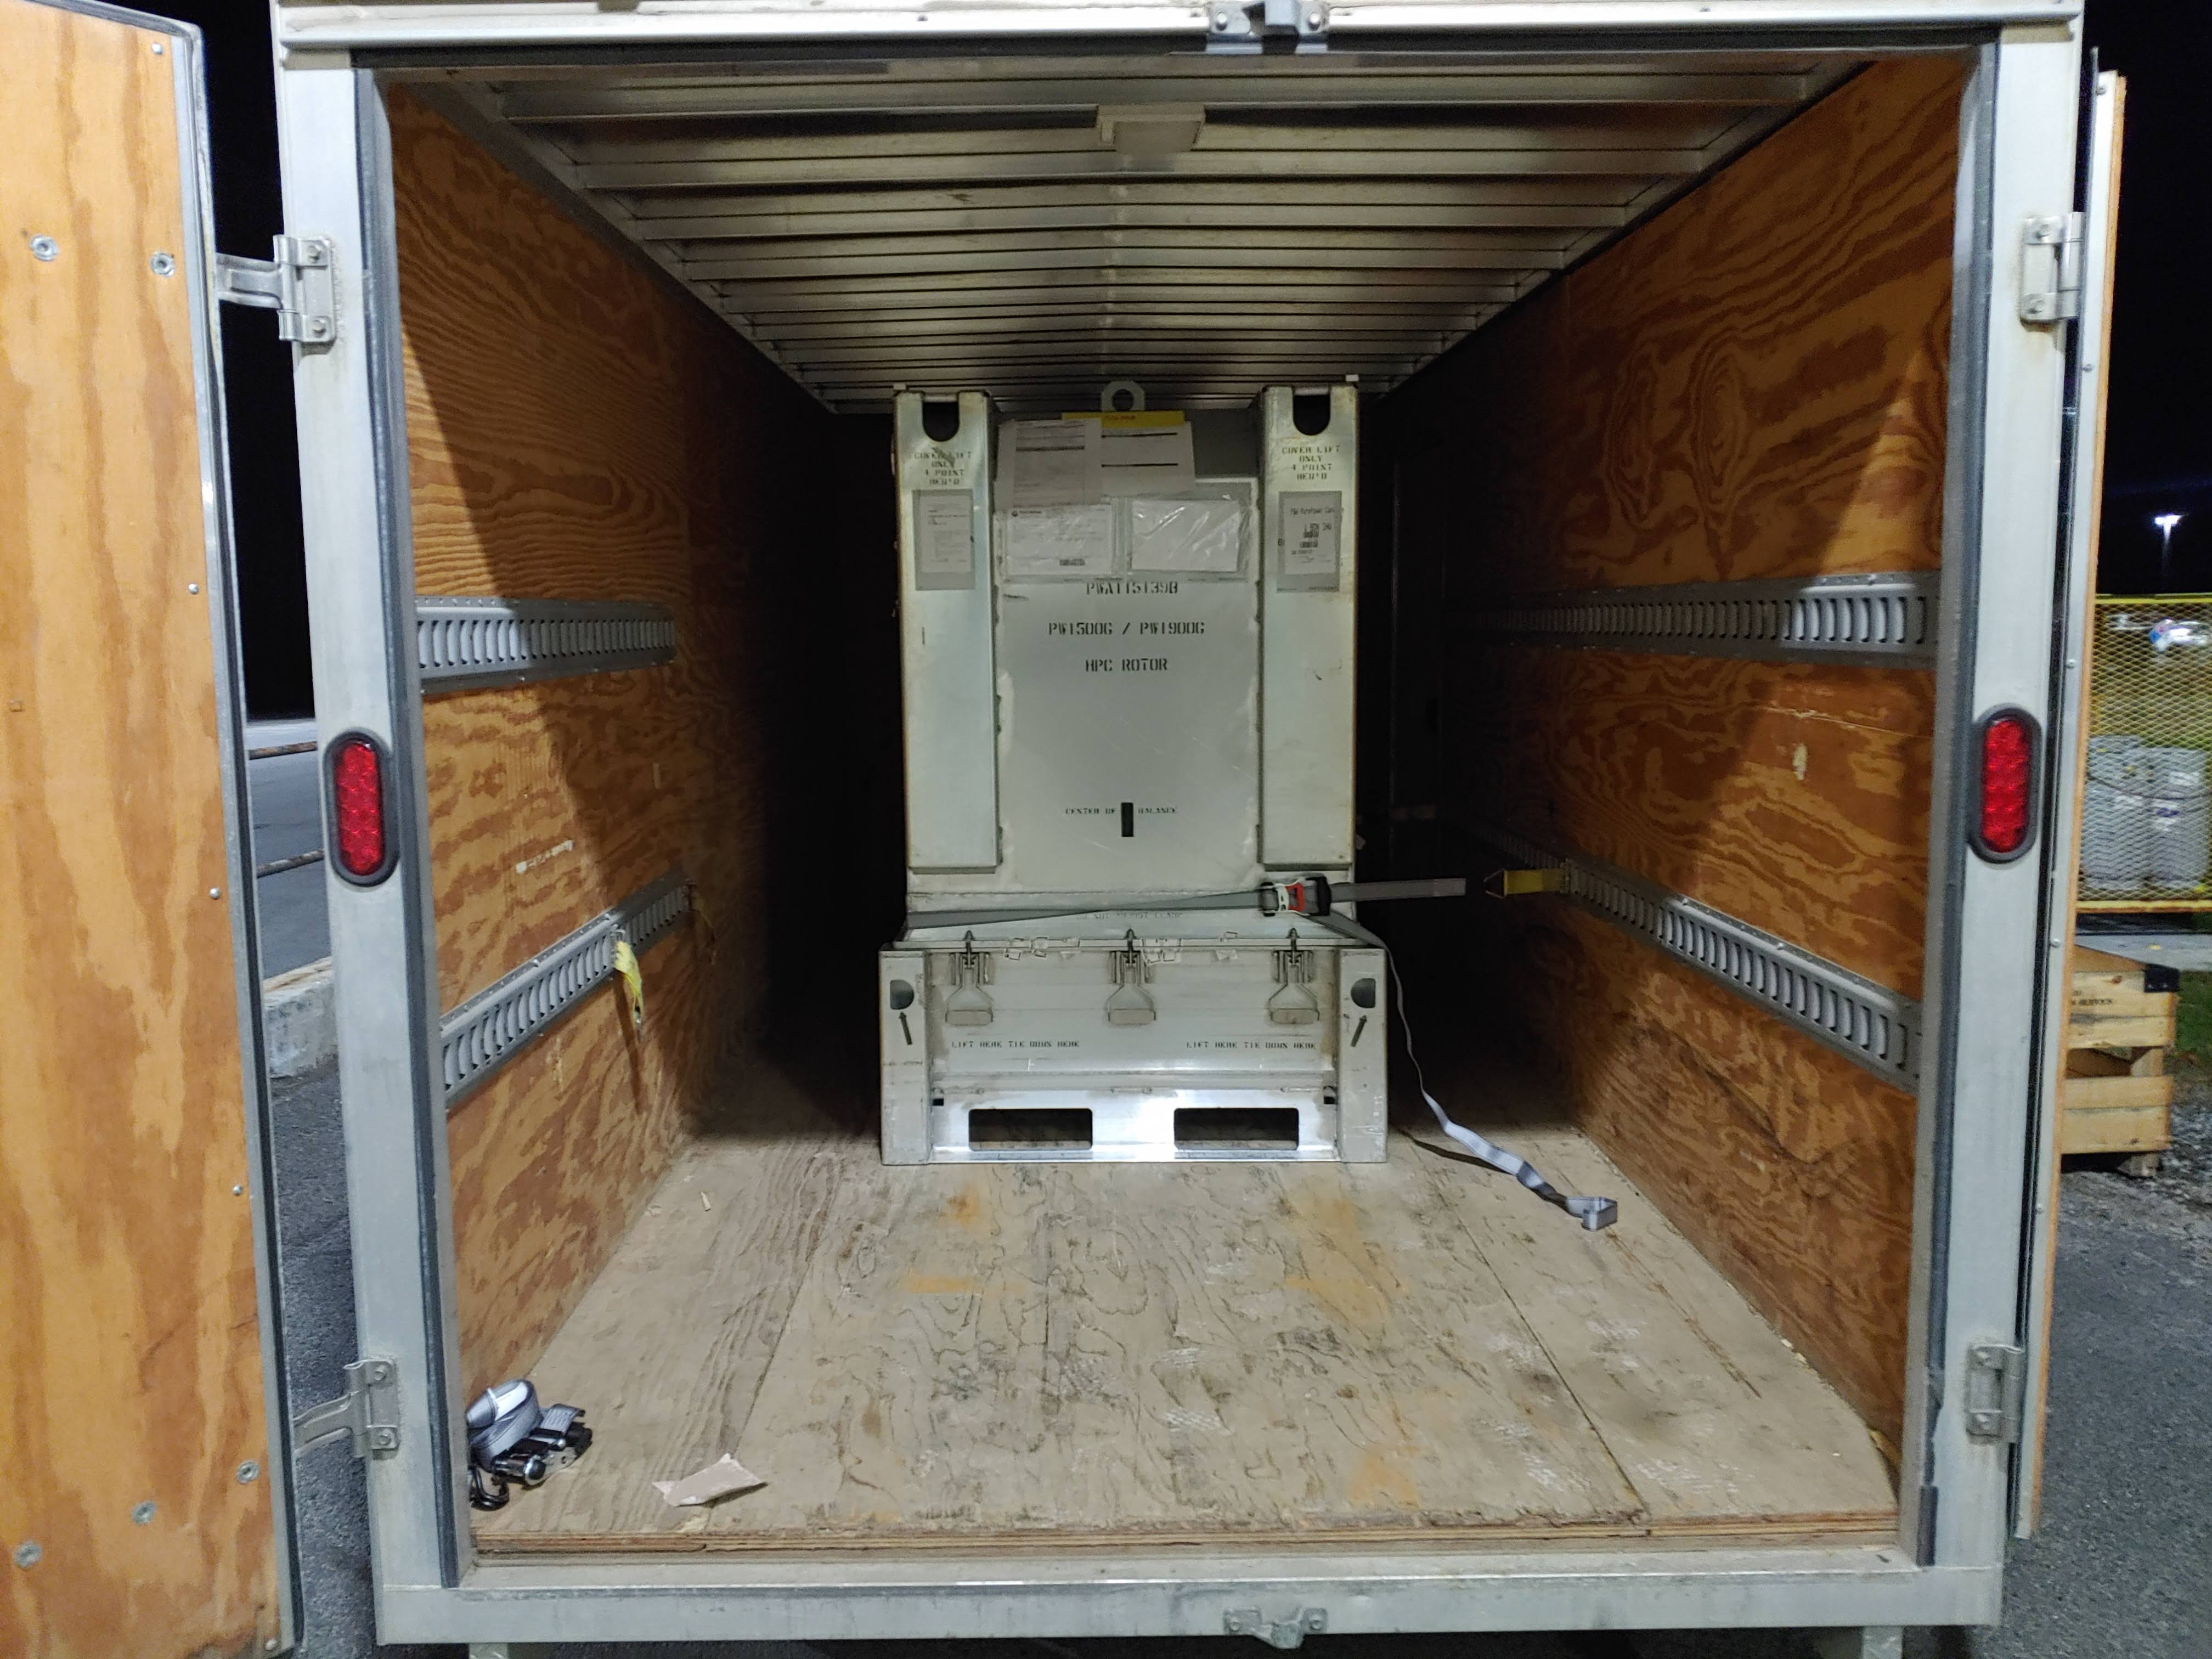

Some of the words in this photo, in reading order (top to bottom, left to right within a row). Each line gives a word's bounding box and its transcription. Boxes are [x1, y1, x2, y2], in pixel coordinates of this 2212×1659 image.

[1317, 445, 1340, 453] LIFT
[1086, 581, 1178, 595] PWA115139B
[1048, 622, 1113, 635] PW1500G
[1122, 622, 1131, 635] /
[1139, 622, 1205, 635] PW1900G
[1085, 659, 1113, 673] HPC
[1121, 658, 1168, 672] ROTOR
